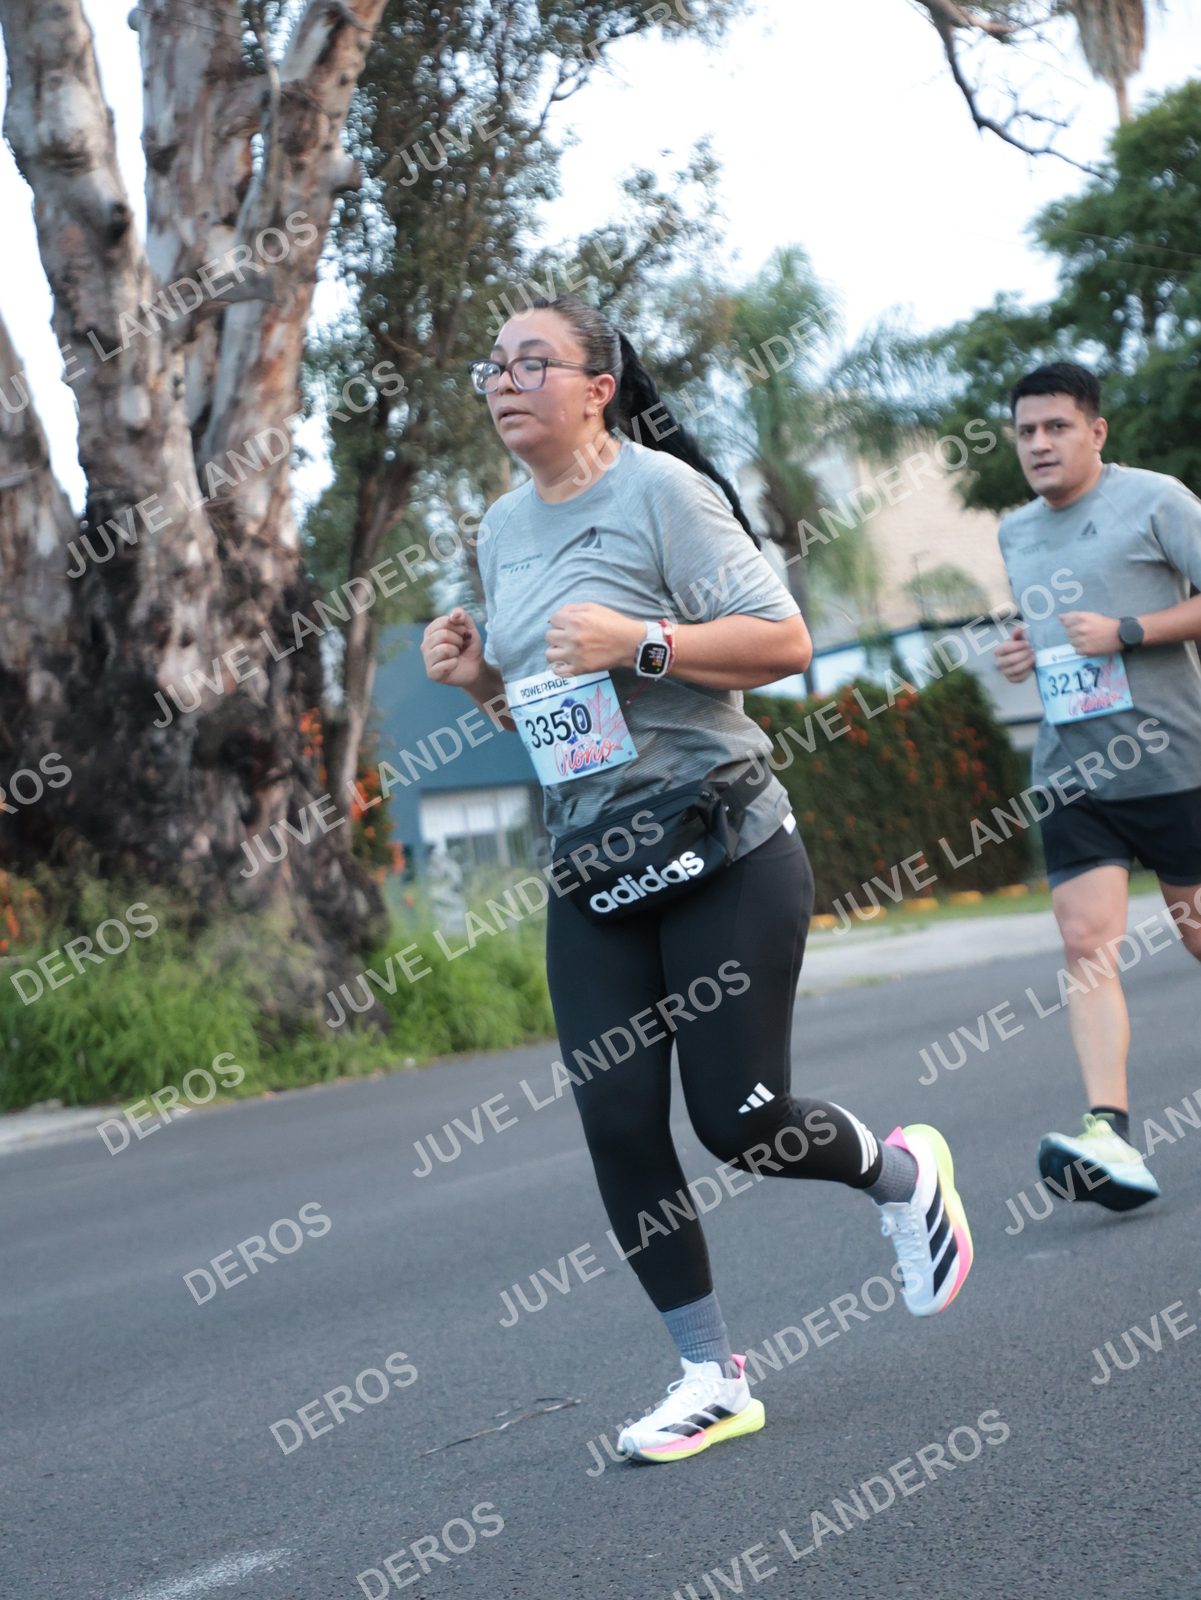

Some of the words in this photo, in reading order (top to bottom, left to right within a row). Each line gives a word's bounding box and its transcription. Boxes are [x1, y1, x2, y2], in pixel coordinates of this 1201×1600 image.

[520, 678, 571, 699] POWERADE
[1048, 666, 1101, 697] 3217
[525, 703, 592, 748] 3350
[589, 850, 705, 913] adidas
